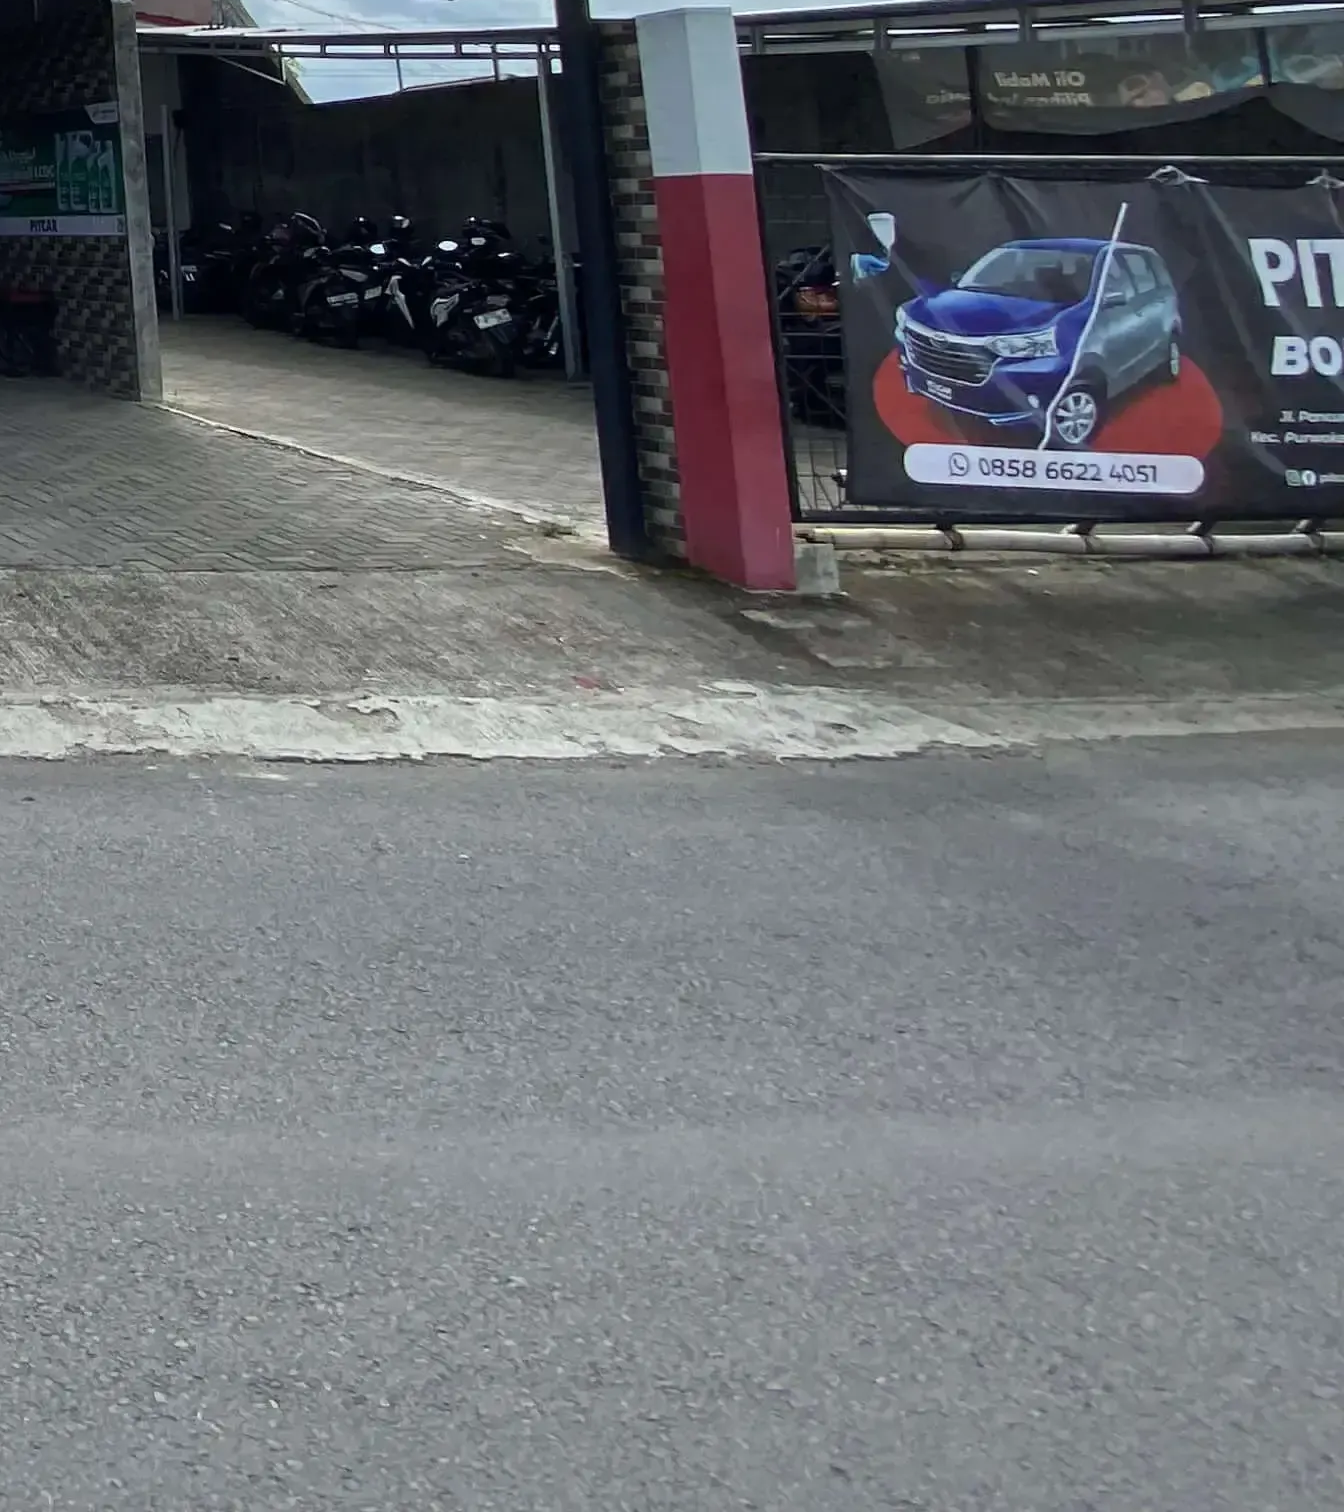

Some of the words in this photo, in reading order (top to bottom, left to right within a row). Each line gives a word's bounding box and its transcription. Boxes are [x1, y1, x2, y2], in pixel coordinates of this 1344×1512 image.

[979, 458, 1037, 479] 0858
[1045, 460, 1103, 482] 6622
[1109, 462, 1158, 484] 4051
